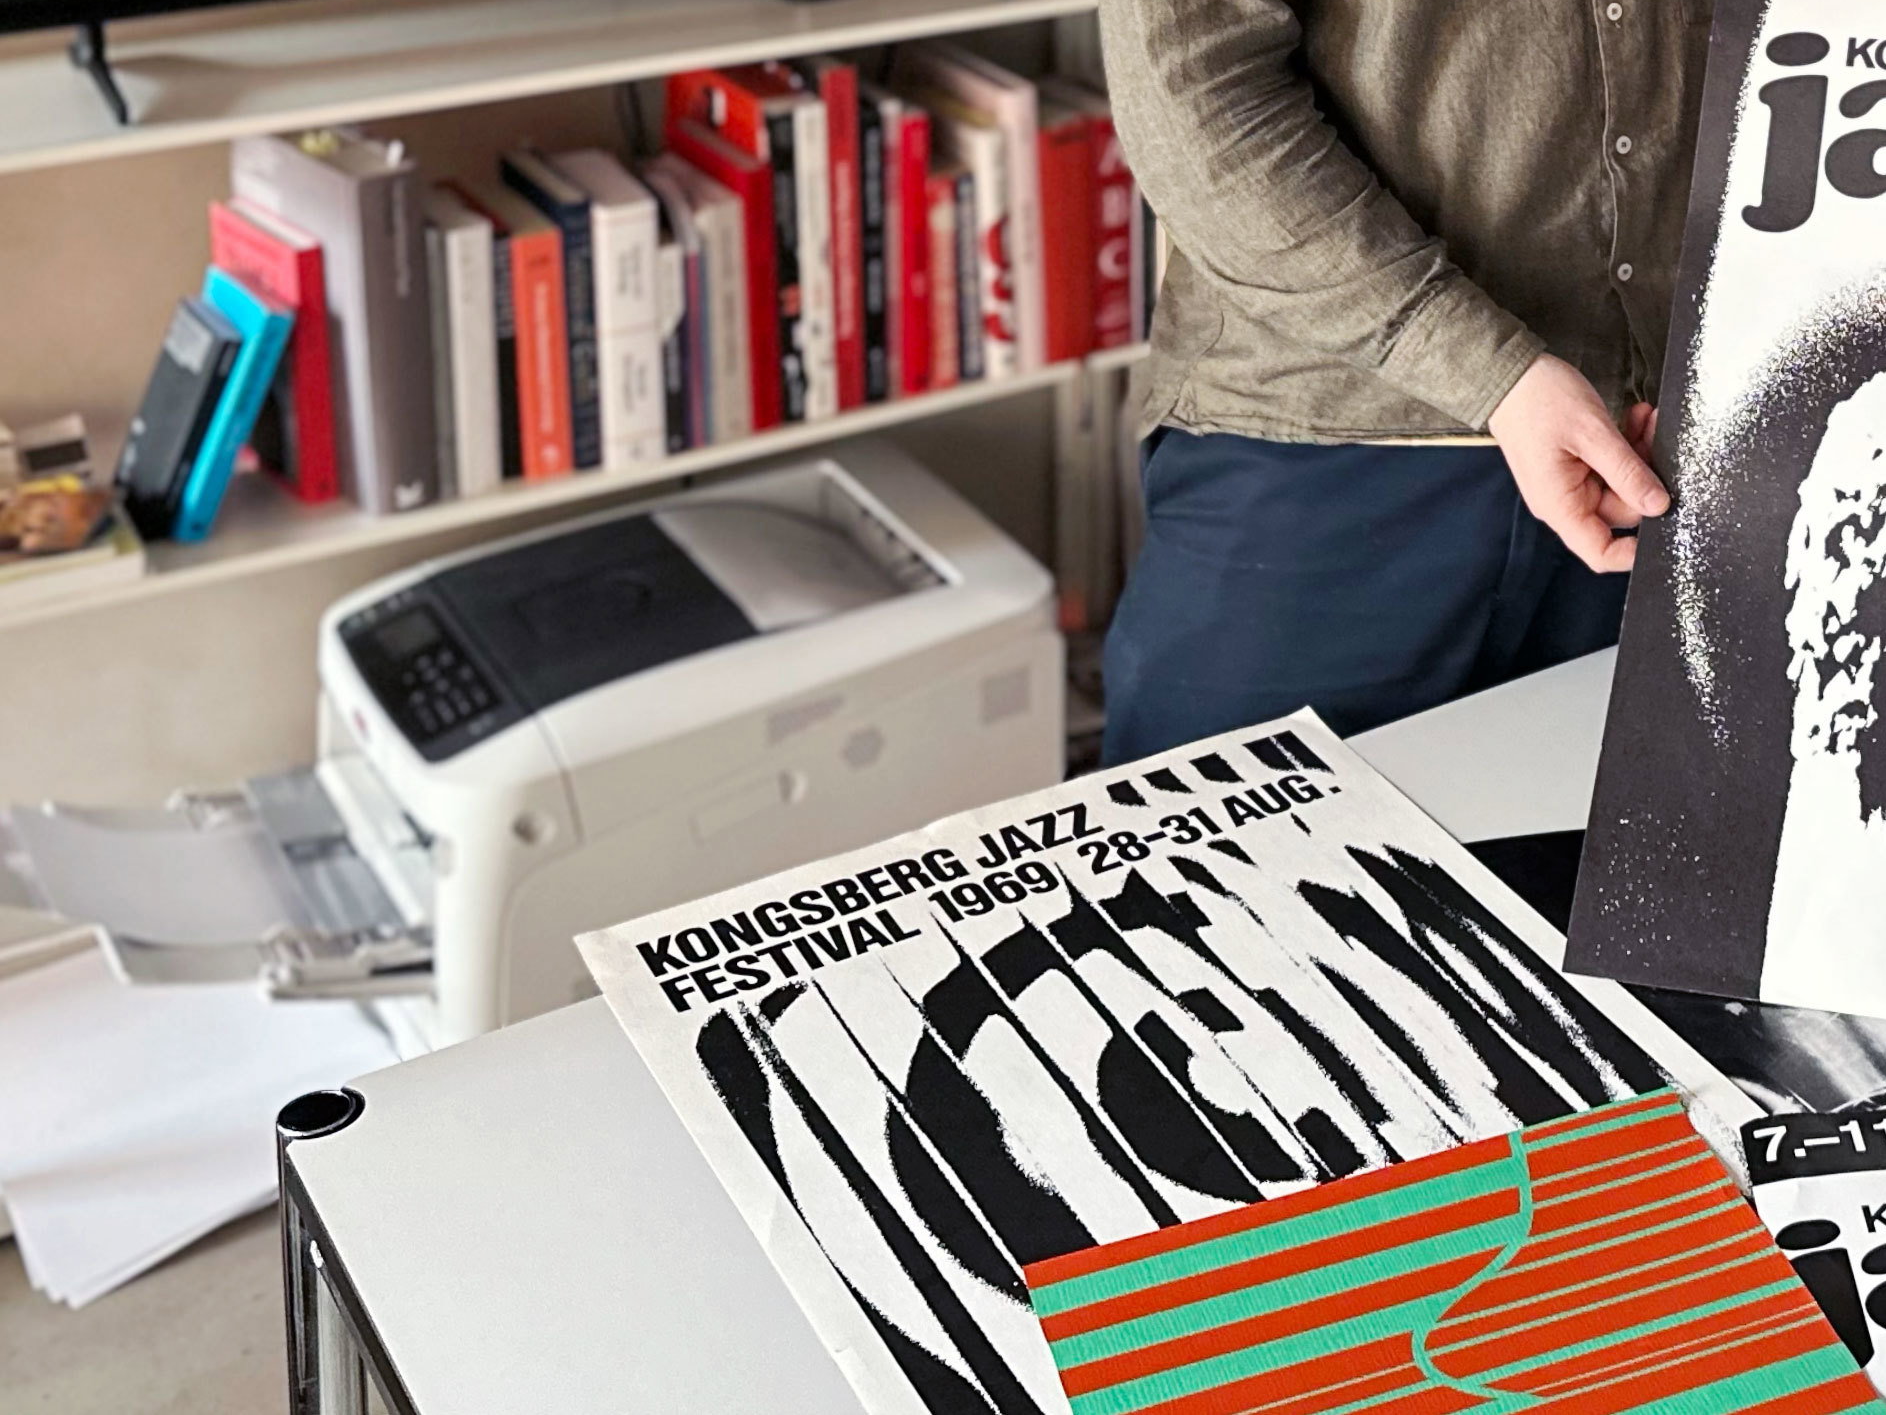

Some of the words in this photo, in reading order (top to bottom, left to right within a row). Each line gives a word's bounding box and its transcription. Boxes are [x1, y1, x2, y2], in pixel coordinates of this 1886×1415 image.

[635, 847, 966, 977] KONGSBERG
[973, 802, 1106, 871] JAZZ
[658, 907, 922, 1014] FESTIVAL
[927, 860, 1062, 927] 1969
[1226, 774, 1343, 829] AUG.
